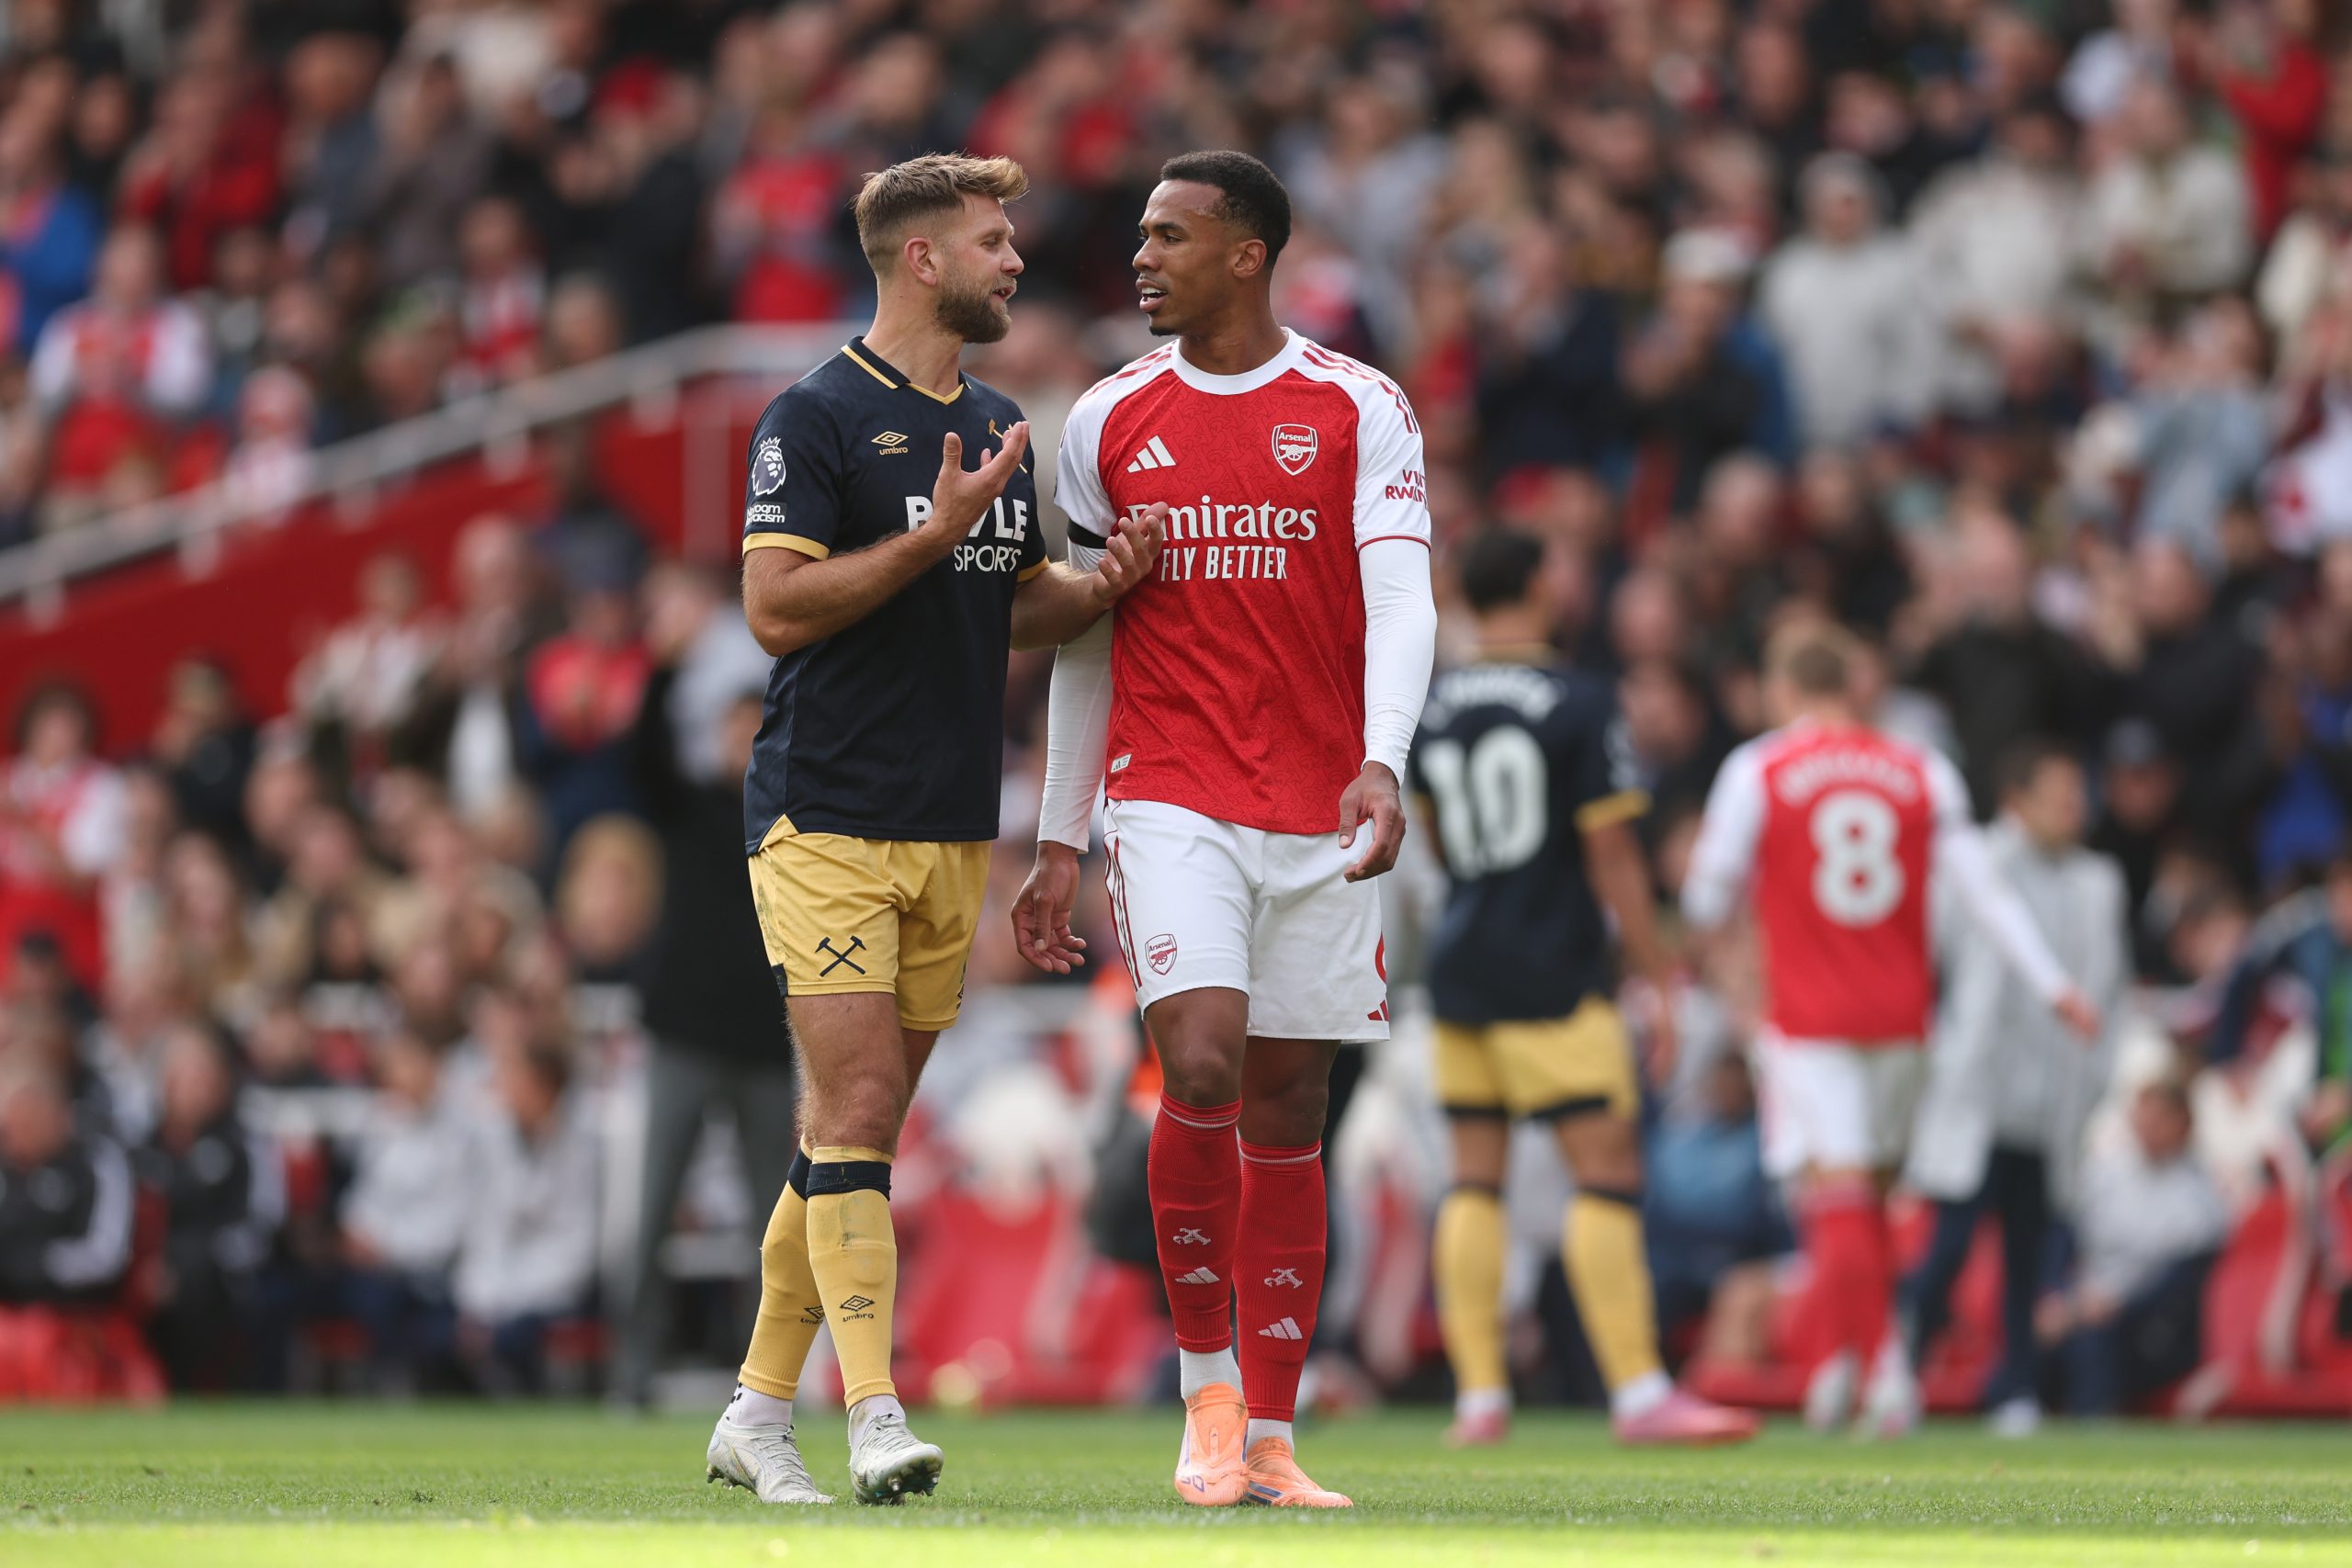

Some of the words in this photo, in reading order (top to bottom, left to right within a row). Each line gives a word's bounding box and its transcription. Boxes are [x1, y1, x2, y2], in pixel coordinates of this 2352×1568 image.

[879, 446, 909, 456] umbro
[1279, 432, 1311, 443] Arsenal
[905, 496, 1028, 542] BLE
[954, 545, 1022, 572] SPORTS
[1160, 547, 1197, 581] FLY
[1205, 546, 1287, 580] BETTER
[1419, 724, 1548, 878] 10
[1809, 789, 1906, 927] 8
[1148, 939, 1172, 953] Arsenal
[842, 1312, 875, 1323] umbro
